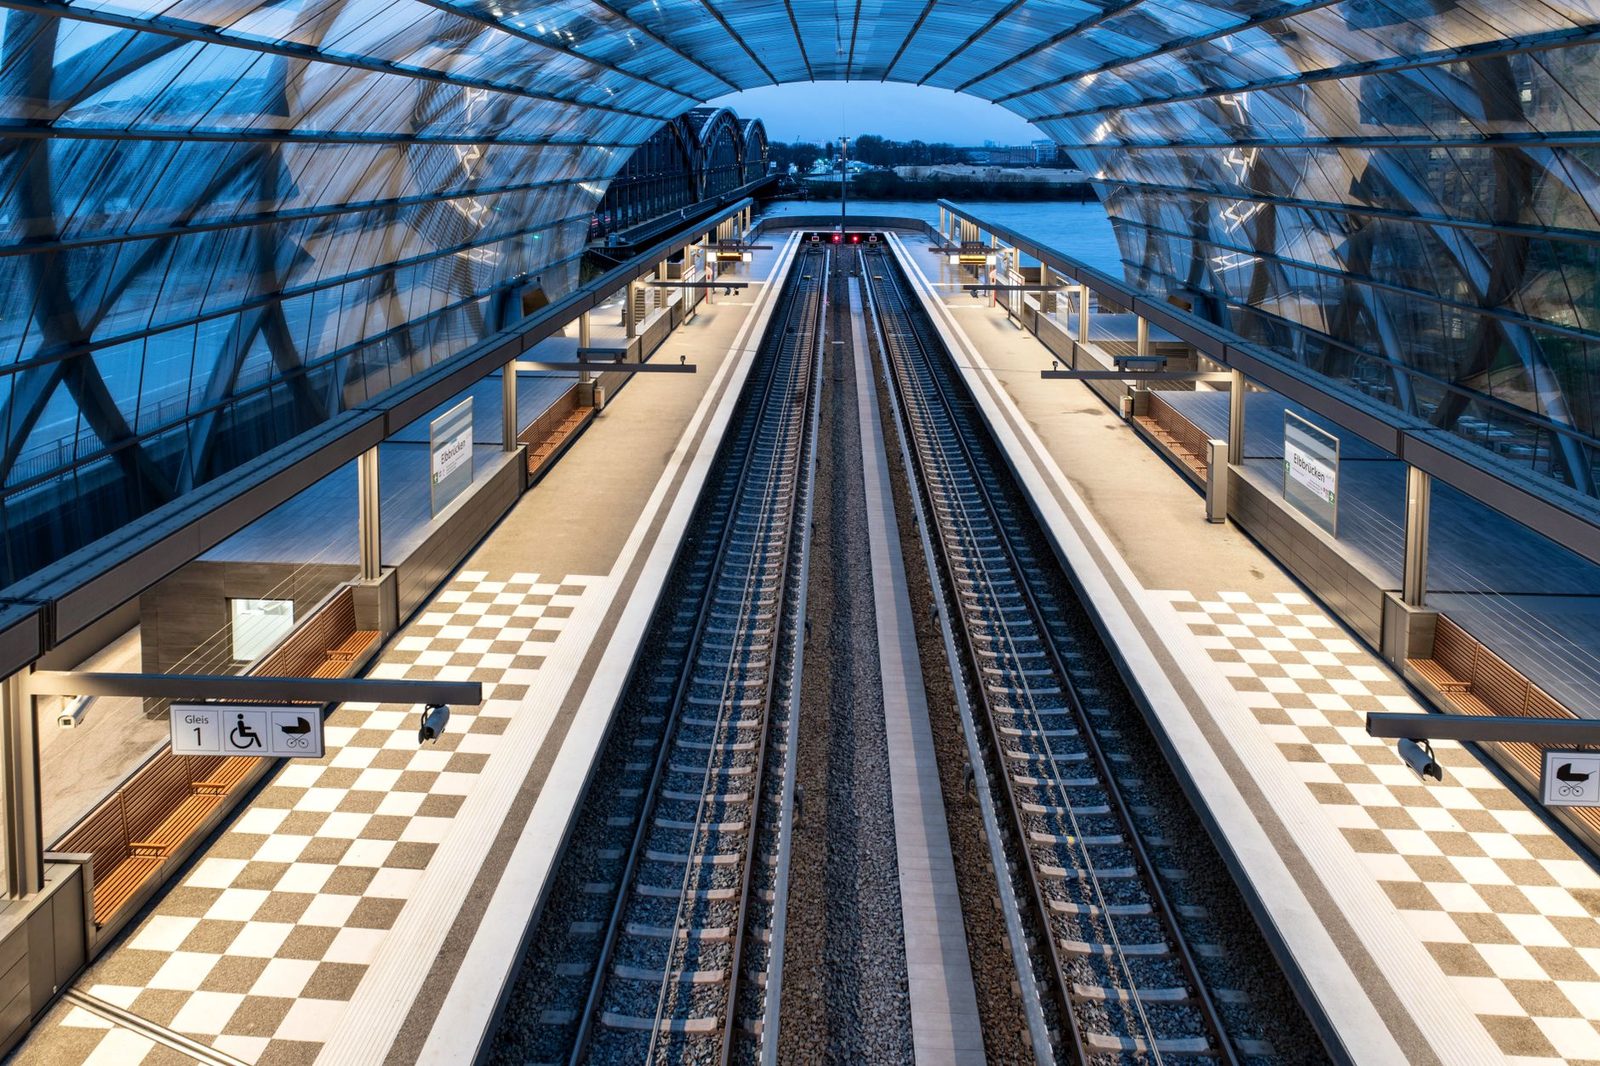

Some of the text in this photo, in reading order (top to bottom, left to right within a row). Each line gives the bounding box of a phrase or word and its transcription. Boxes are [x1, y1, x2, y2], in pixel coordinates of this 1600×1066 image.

[441, 440, 466, 465] Elbbrücken
[1293, 453, 1325, 483] Elbbrücken
[184, 714, 209, 725] Gleis
[193, 727, 202, 746] 1
